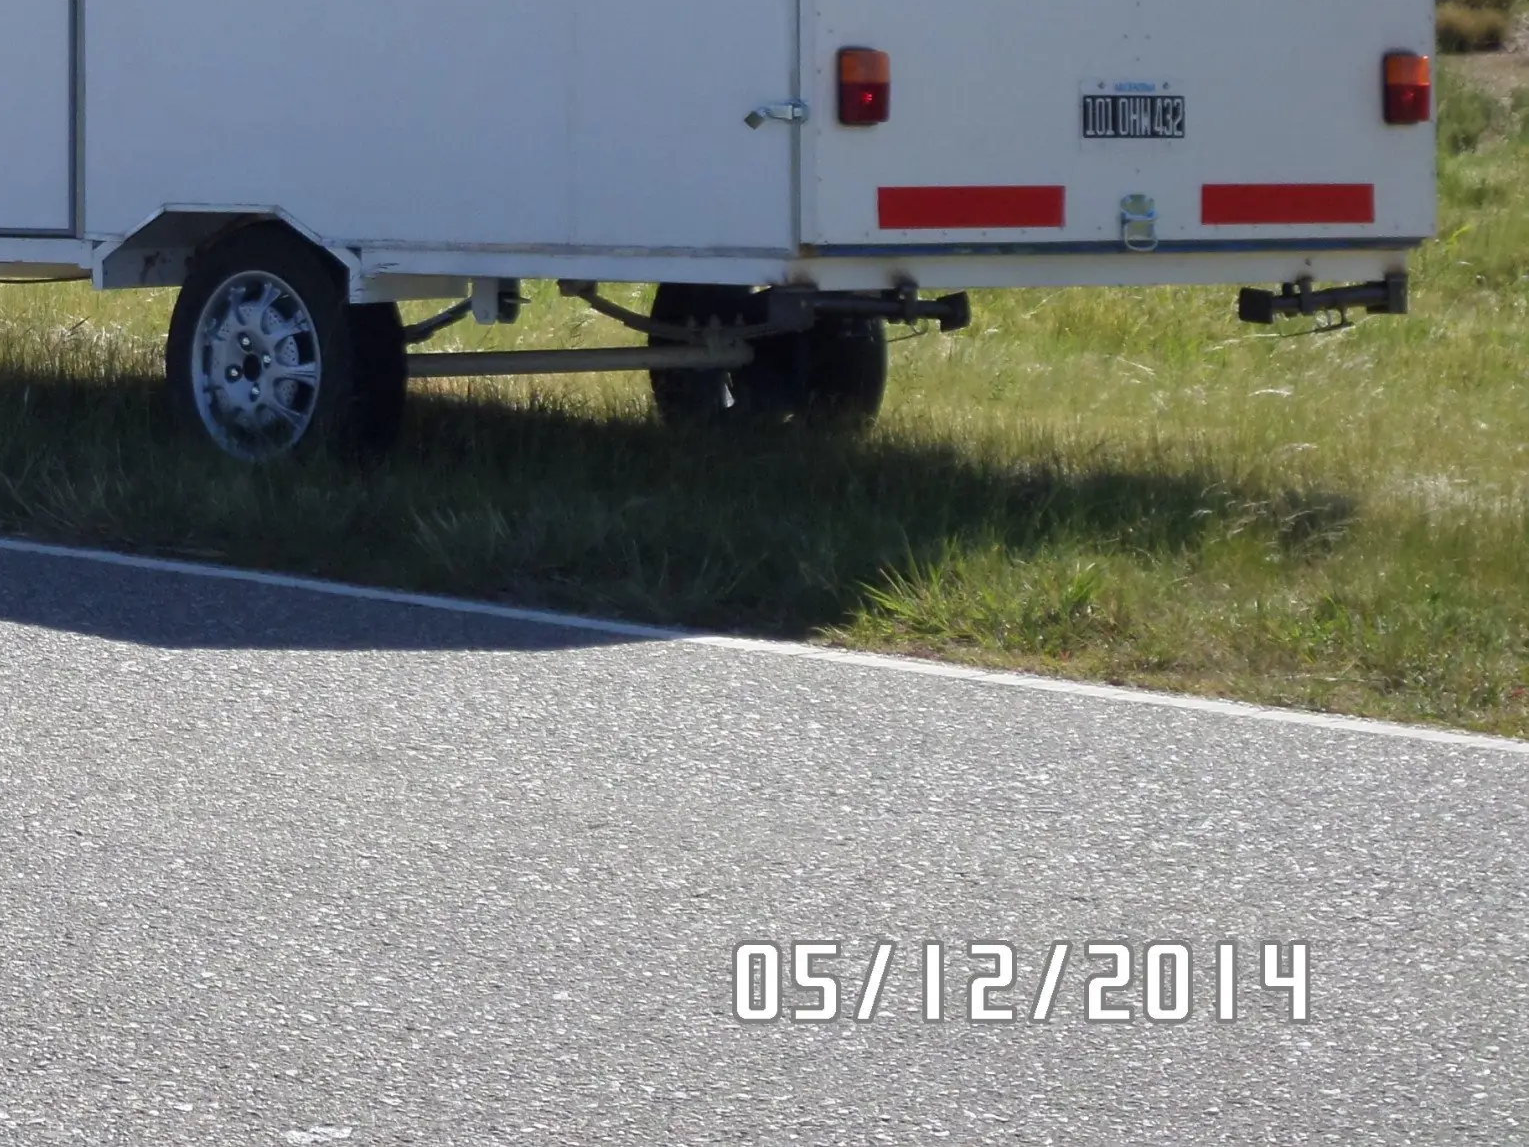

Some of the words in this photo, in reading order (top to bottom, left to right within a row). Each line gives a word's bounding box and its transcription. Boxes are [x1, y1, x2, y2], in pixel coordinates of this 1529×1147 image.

[1085, 97, 1115, 135] 101
[1118, 97, 1151, 135] OHW
[1154, 98, 1184, 136] 432
